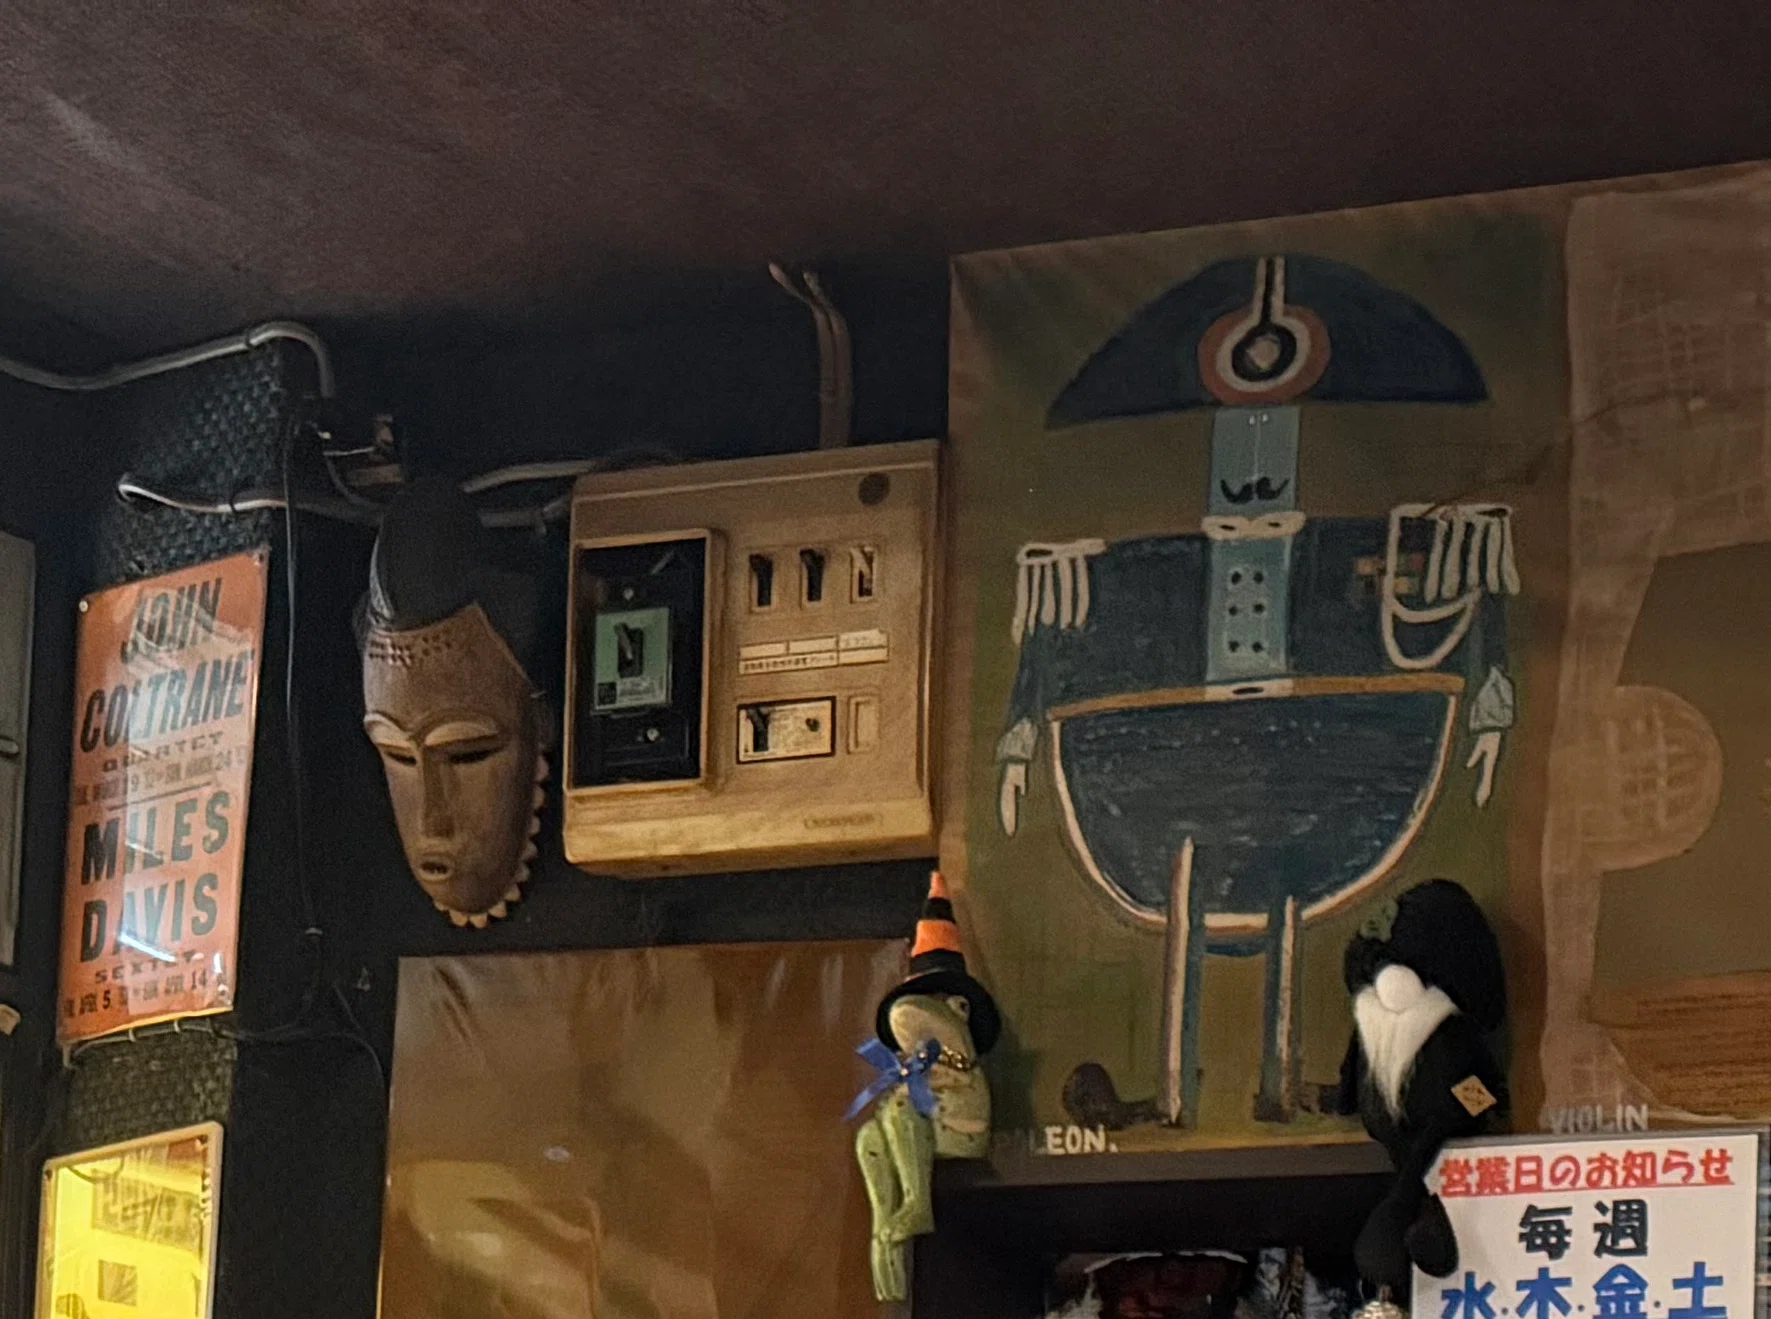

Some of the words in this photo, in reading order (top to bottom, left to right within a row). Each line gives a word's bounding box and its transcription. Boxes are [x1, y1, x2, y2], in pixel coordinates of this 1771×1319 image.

[121, 577, 222, 664] JOHN
[79, 649, 255, 752] COLTRANE
[81, 791, 230, 885] MILES
[80, 872, 219, 963] DAVIS
[1439, 1148, 1734, 1197] 営業日のお知らせ
[1519, 1199, 1649, 1260] 毎週
